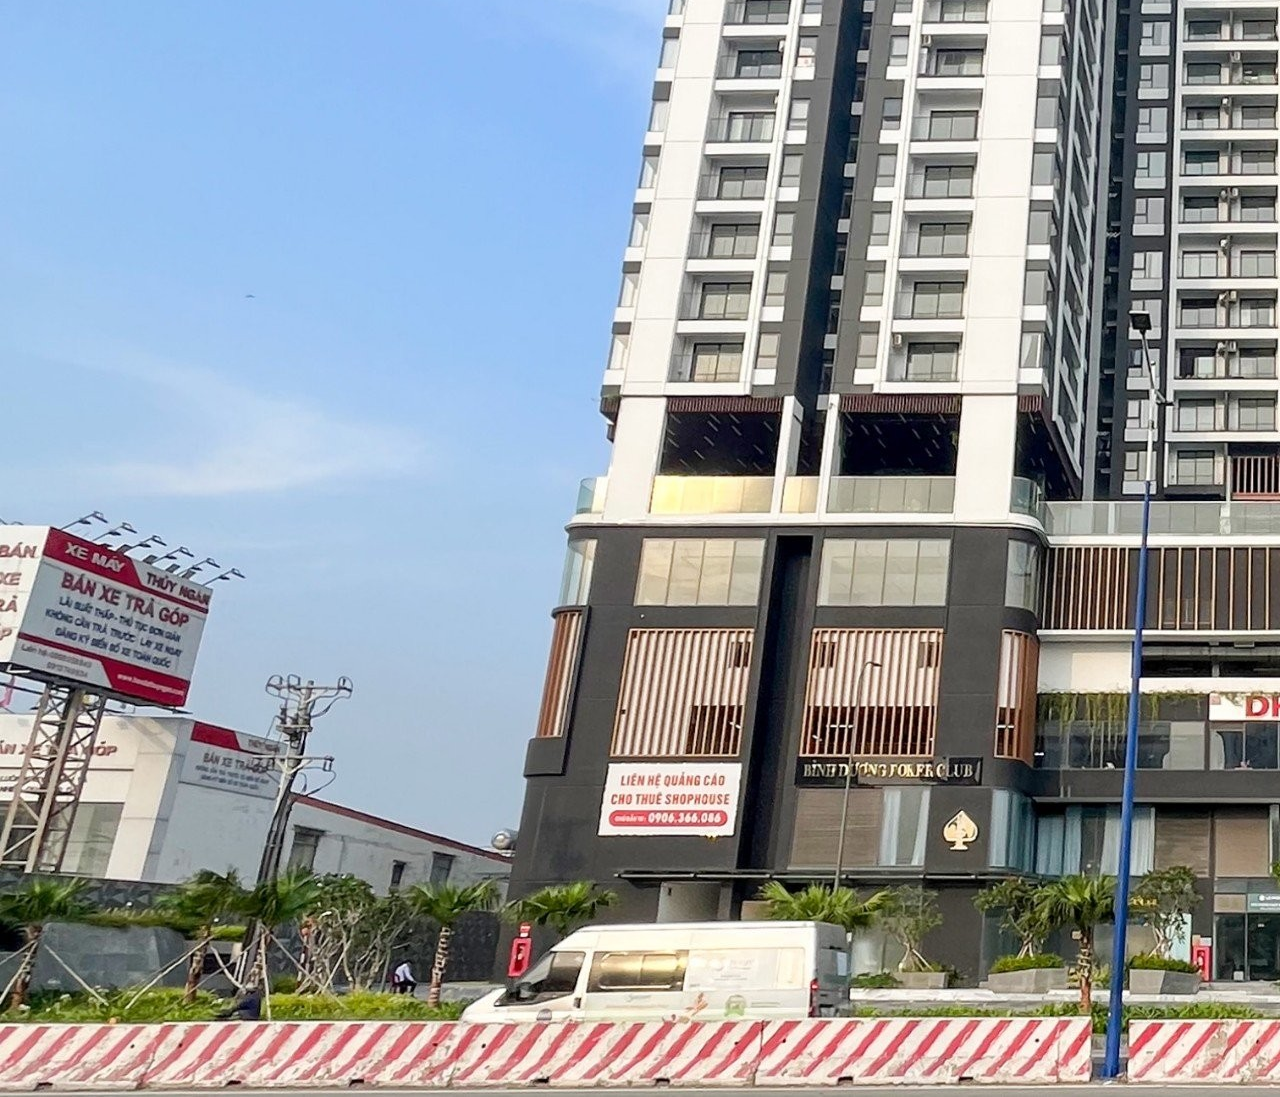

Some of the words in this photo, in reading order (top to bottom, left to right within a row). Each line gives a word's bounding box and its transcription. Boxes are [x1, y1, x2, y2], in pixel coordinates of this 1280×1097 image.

[65, 542, 88, 561] XE
[91, 554, 126, 573] MÁY
[61, 571, 97, 598] BÁN
[98, 584, 122, 606] XE
[125, 594, 155, 618] TRẢ
[158, 606, 189, 627] GÓP
[92, 621, 108, 635] TRẢ
[803, 759, 837, 778] BÌNH
[936, 762, 974, 779] CLUB
[620, 771, 645, 786] LIÊN
[647, 771, 661, 788] HỆ
[664, 771, 701, 787] QUẢNG
[703, 772, 726, 786] CÁO
[611, 793, 633, 805] CHO
[635, 792, 663, 805] THUÊ
[665, 793, 730, 805] SHOPHOUSE
[647, 811, 722, 824] 0906.366.086
